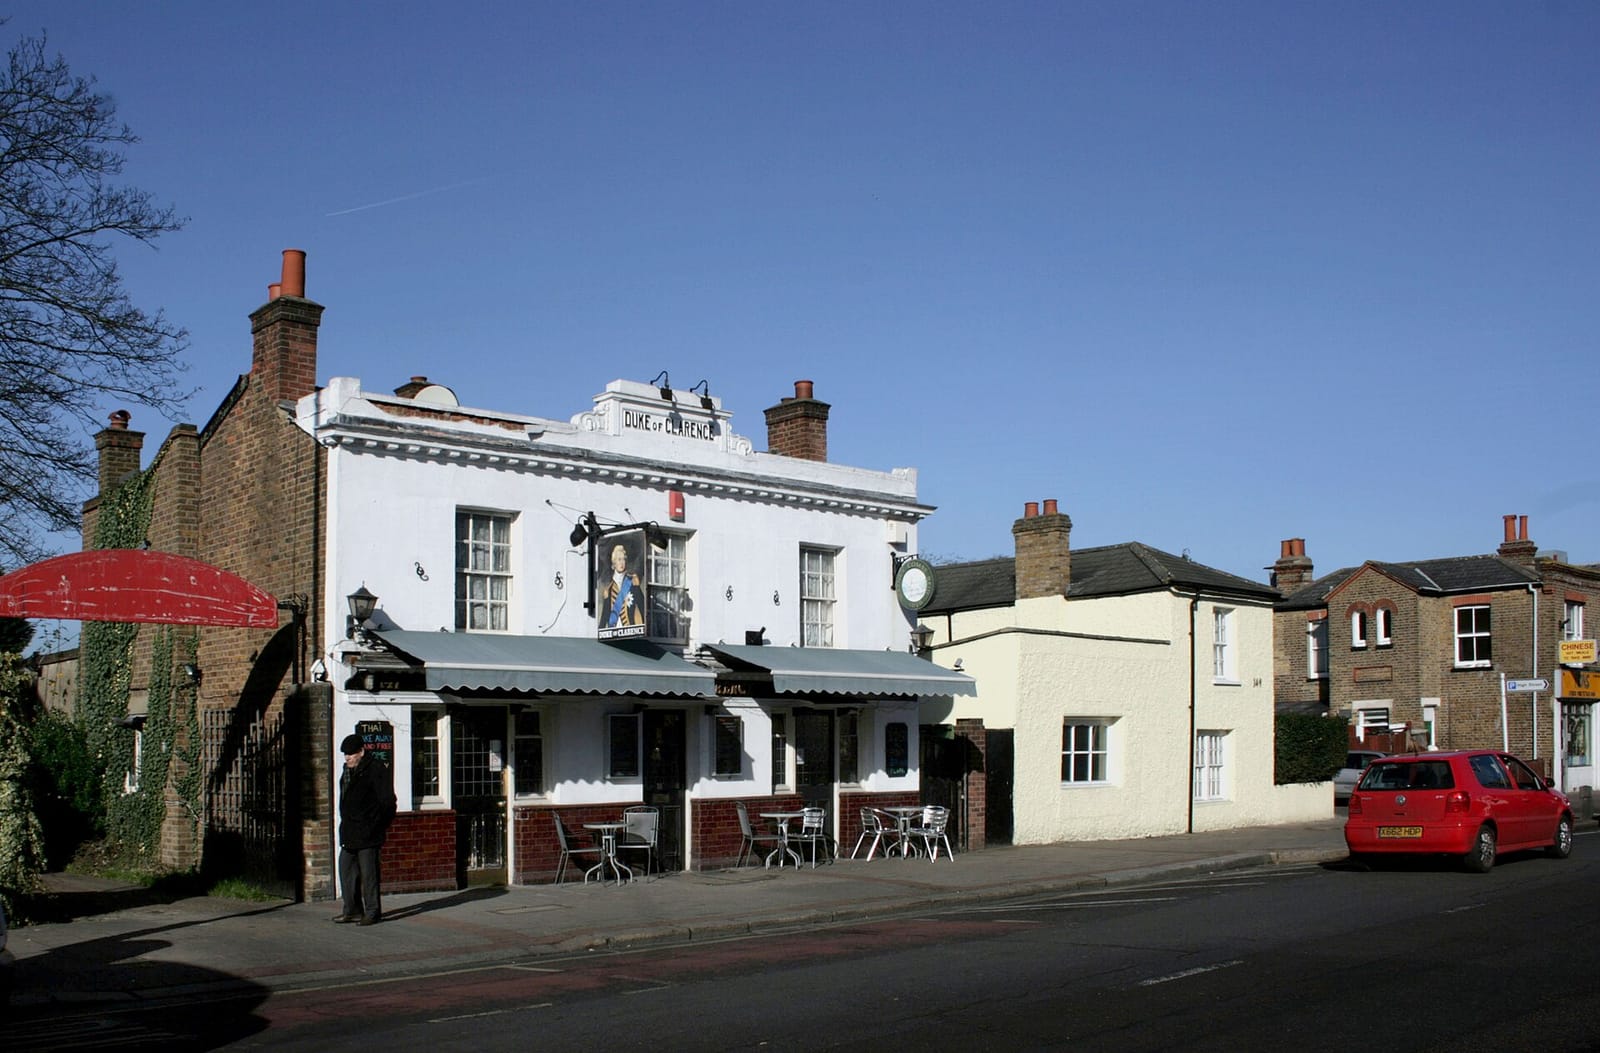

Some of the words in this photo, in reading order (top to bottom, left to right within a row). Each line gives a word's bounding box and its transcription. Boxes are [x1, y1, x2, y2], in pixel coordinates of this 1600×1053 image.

[624, 411, 651, 431] DUKE
[652, 422, 663, 432] OF
[665, 418, 714, 440] CLARENCE
[618, 626, 645, 637] CLARENCE
[1382, 827, 1403, 836] X662
